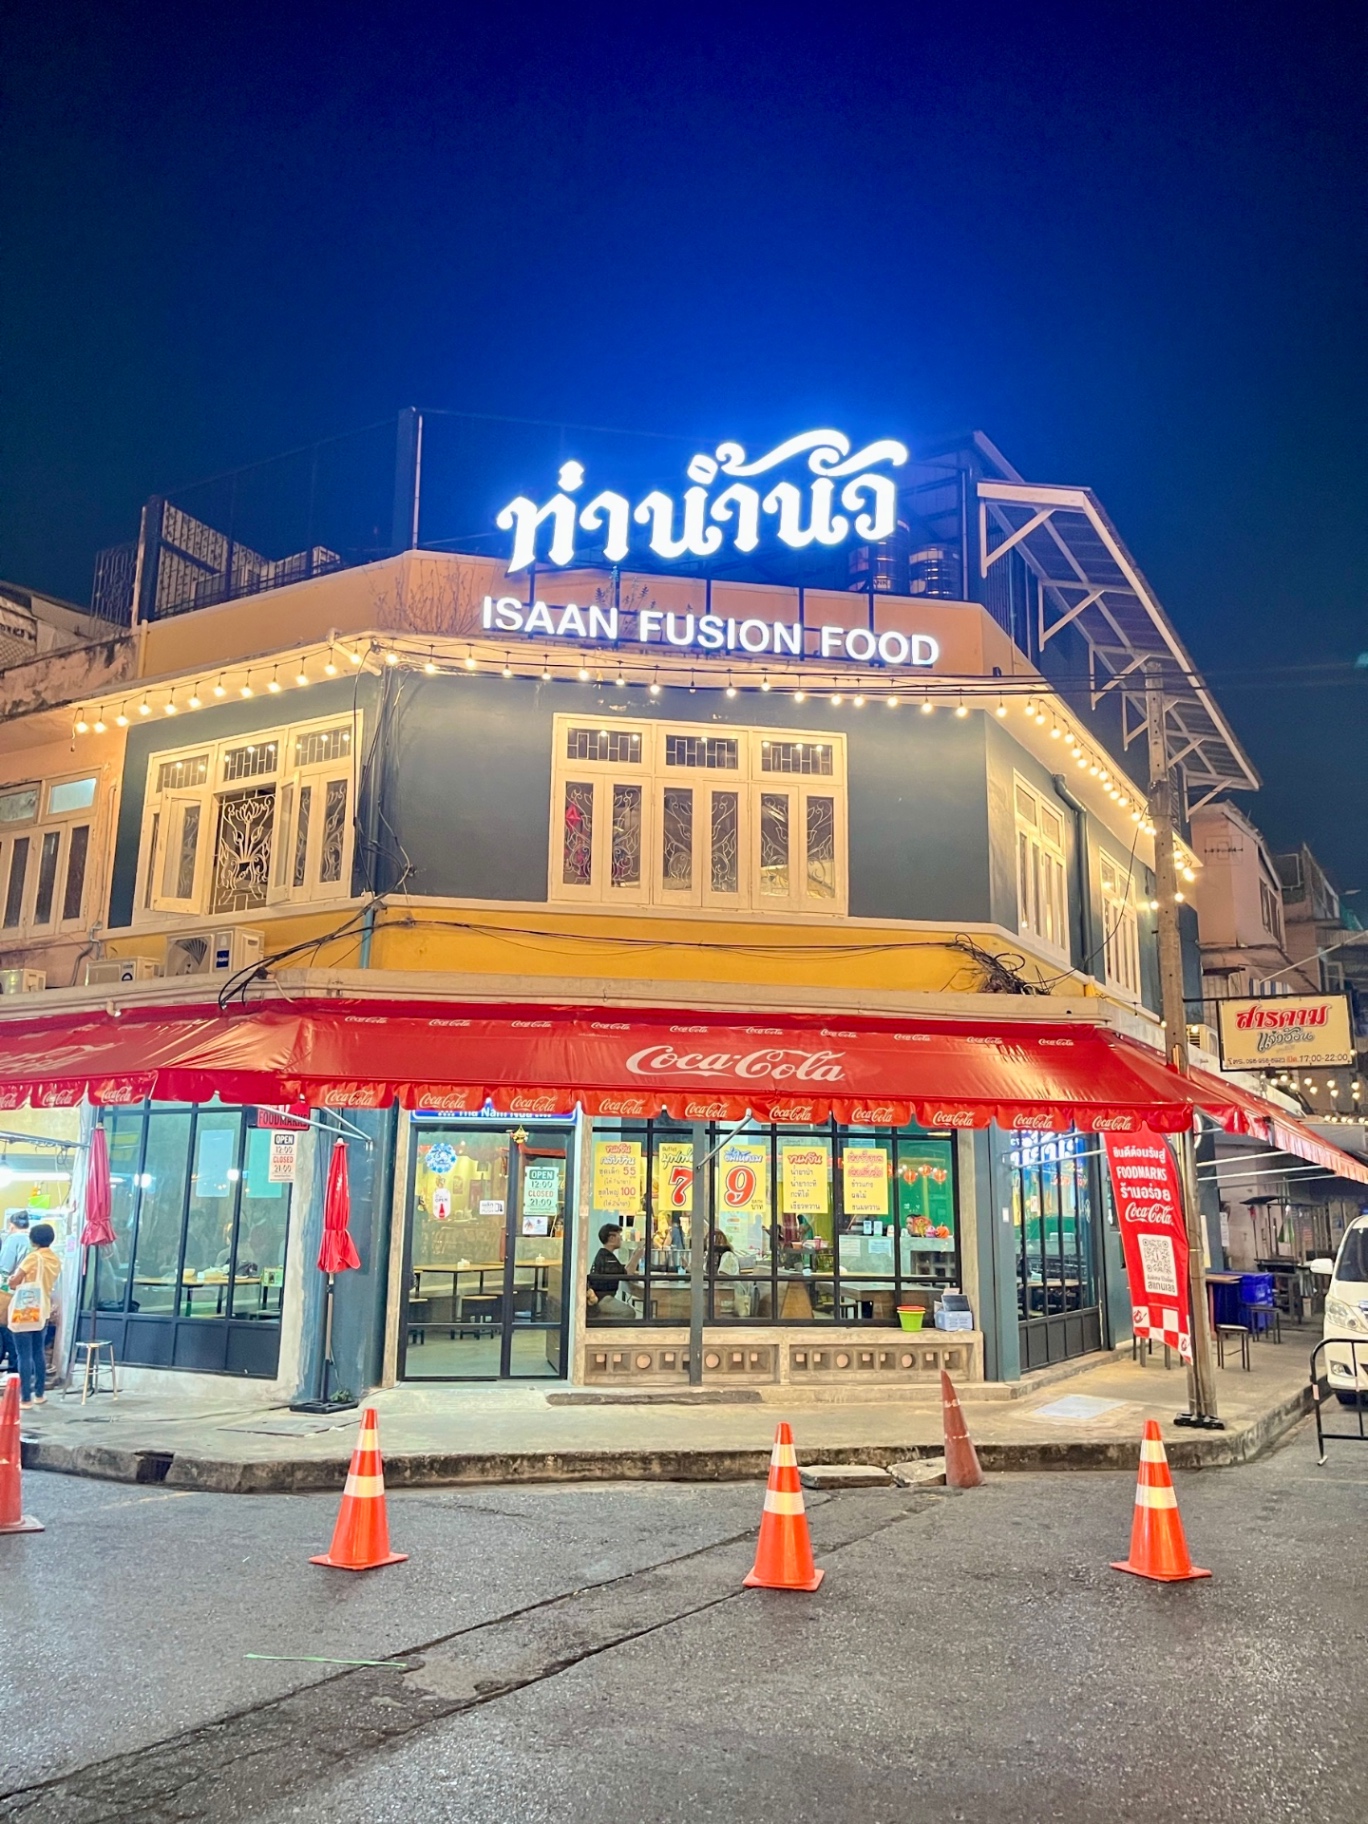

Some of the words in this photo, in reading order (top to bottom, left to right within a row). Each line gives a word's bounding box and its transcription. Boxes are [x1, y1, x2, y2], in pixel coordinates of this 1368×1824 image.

[482, 596, 618, 639] ISAAN
[638, 610, 801, 654] FUSION
[820, 626, 940, 665] FOOD
[1236, 1003, 1332, 1030] สารคาม
[626, 1045, 846, 1082] Coca-Cola
[325, 1089, 375, 1106] Coca-Cola
[419, 1092, 466, 1109] Coca-Cola
[510, 1095, 555, 1112] Coca-Cola
[599, 1097, 646, 1115] Coca-Cola
[685, 1102, 729, 1118] Coca-Cola
[769, 1105, 813, 1121] Coca-Cola
[852, 1107, 894, 1123] Coca-Cola
[932, 1110, 974, 1126] Coca-Cola
[1013, 1112, 1053, 1129] Coca-Cola
[1092, 1115, 1133, 1131] Coca-Cola
[276, 1135, 293, 1144] OPEN
[273, 1156, 294, 1164] CLOSED
[787, 1152, 823, 1166] ขนมจีน
[531, 1170, 553, 1179] OPEN
[623, 1166, 636, 1176] 55
[1116, 1166, 1167, 1181] FOODMARKS
[528, 1190, 553, 1198] CLOSED
[621, 1187, 636, 1196] 100
[670, 1165, 693, 1207] 7
[724, 1165, 756, 1208] 9
[1120, 1182, 1171, 1201] ร้านอร่อย
[751, 1203, 764, 1211] บาท
[1125, 1202, 1174, 1226] Coca-Cola
